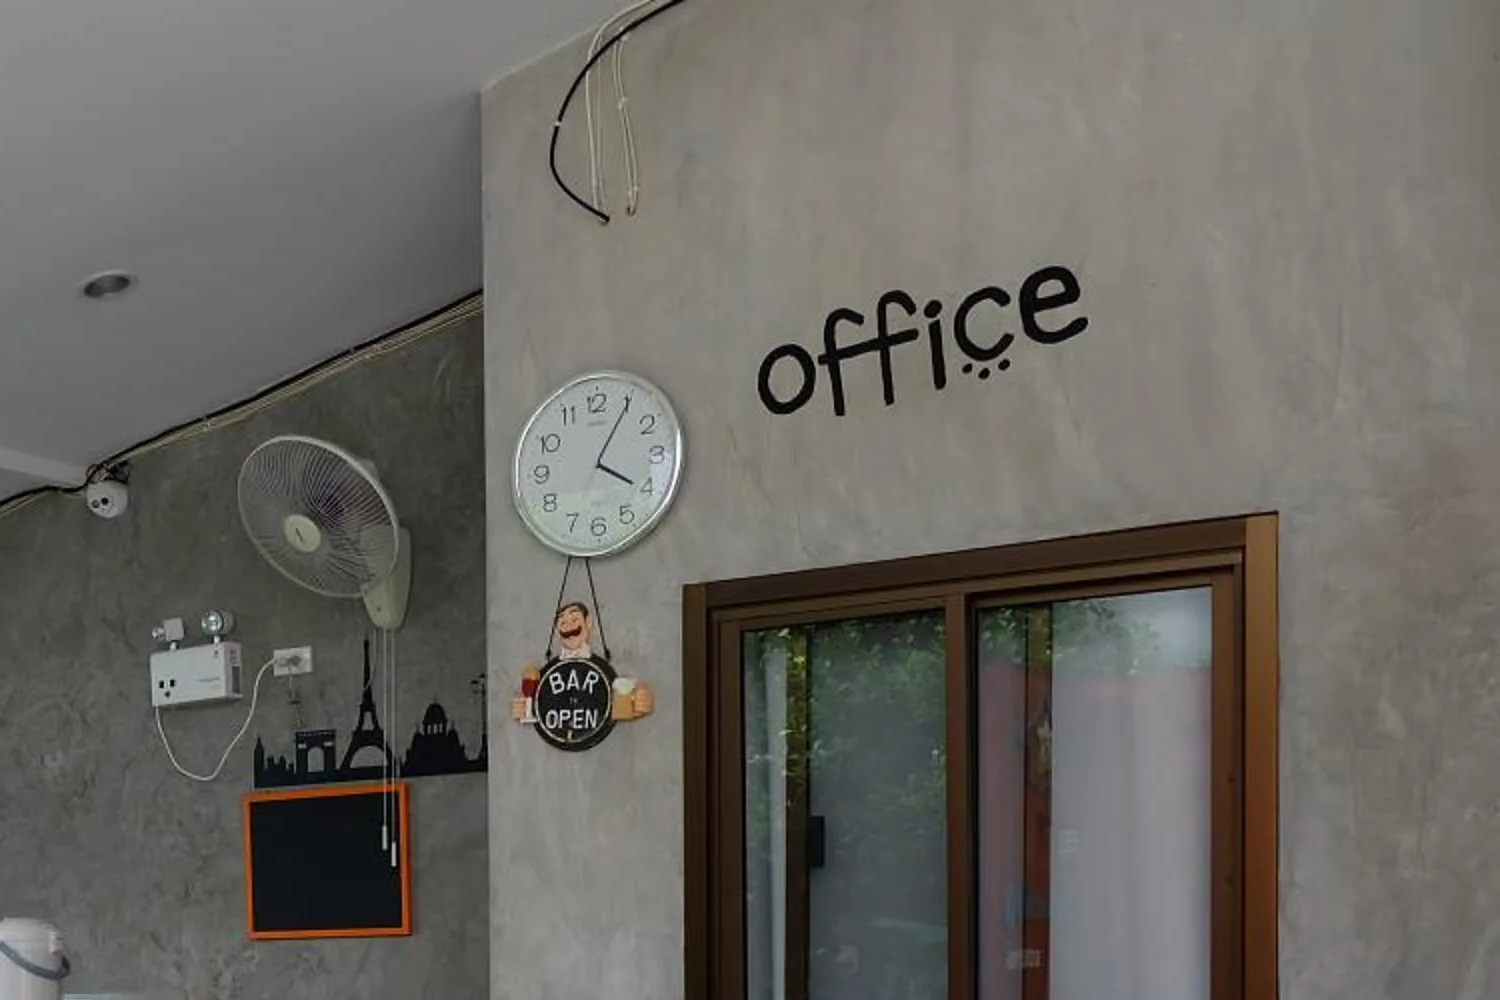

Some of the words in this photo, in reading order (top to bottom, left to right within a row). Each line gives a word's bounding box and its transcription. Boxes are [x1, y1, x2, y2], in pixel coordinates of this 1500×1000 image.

[757, 265, 1089, 416] office
[587, 393, 607, 413] 12
[562, 405, 576, 425] 11
[639, 415, 655, 435] 2
[540, 434, 561, 454] 10
[649, 445, 665, 464] 3
[534, 464, 550, 484] 9
[640, 477, 654, 495] 4
[543, 493, 557, 512] 8
[565, 513, 579, 533] 7
[619, 504, 635, 525] 5
[590, 517, 607, 536] 6
[549, 669, 599, 695] BAR
[546, 709, 598, 729] OPEN
